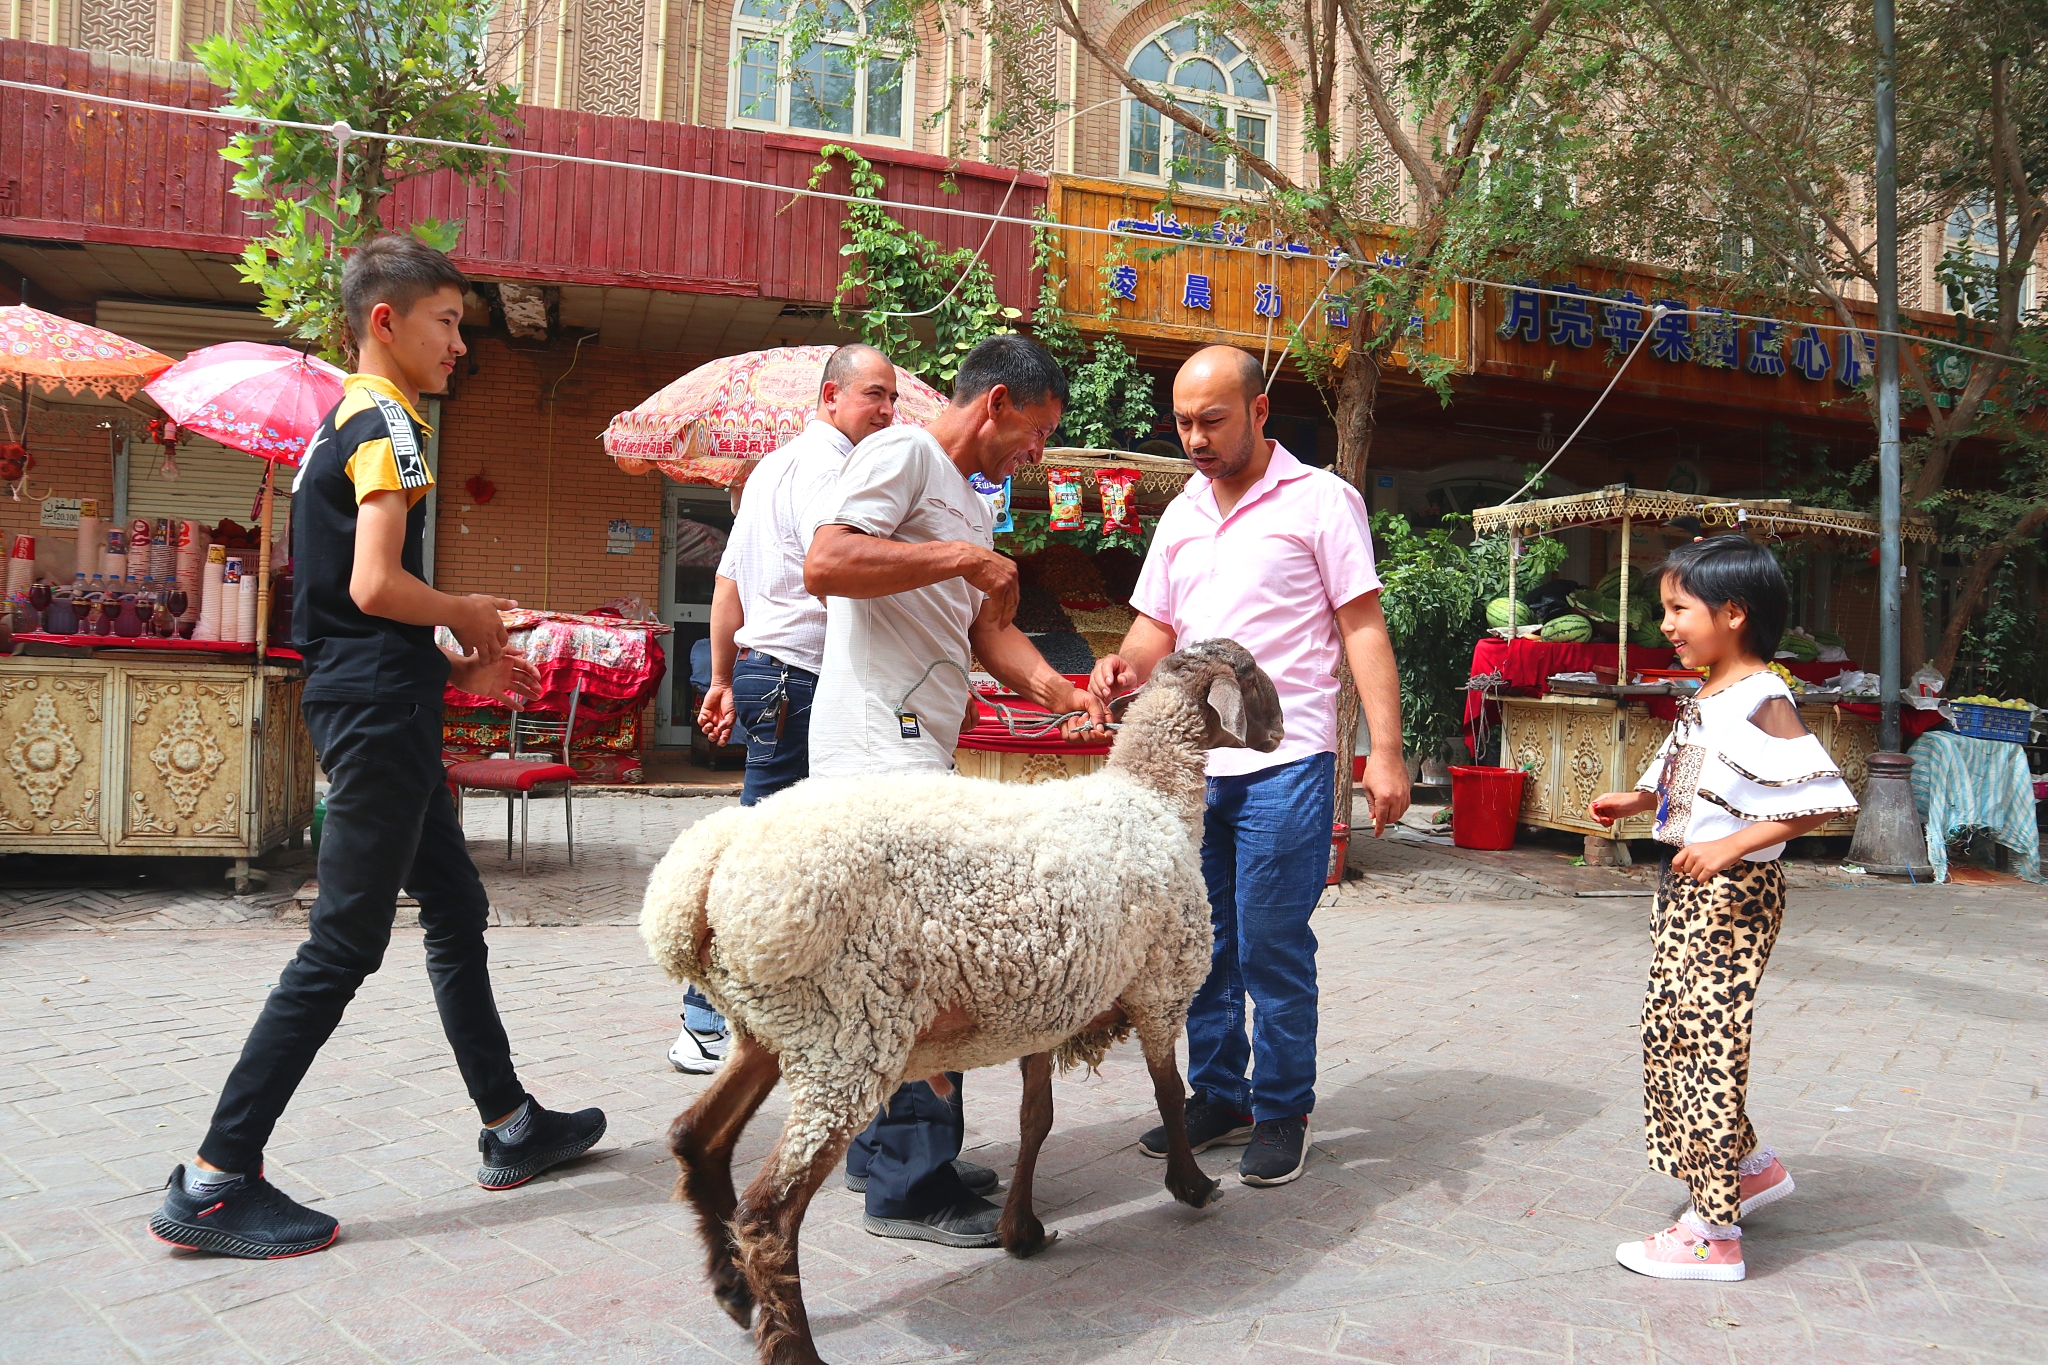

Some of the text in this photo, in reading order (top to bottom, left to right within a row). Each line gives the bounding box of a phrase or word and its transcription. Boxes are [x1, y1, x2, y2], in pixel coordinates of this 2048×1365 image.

[1109, 264, 1424, 339] 凌晨汤面
[390, 418, 416, 457] PUMA
[718, 440, 777, 454] 丝路风情
